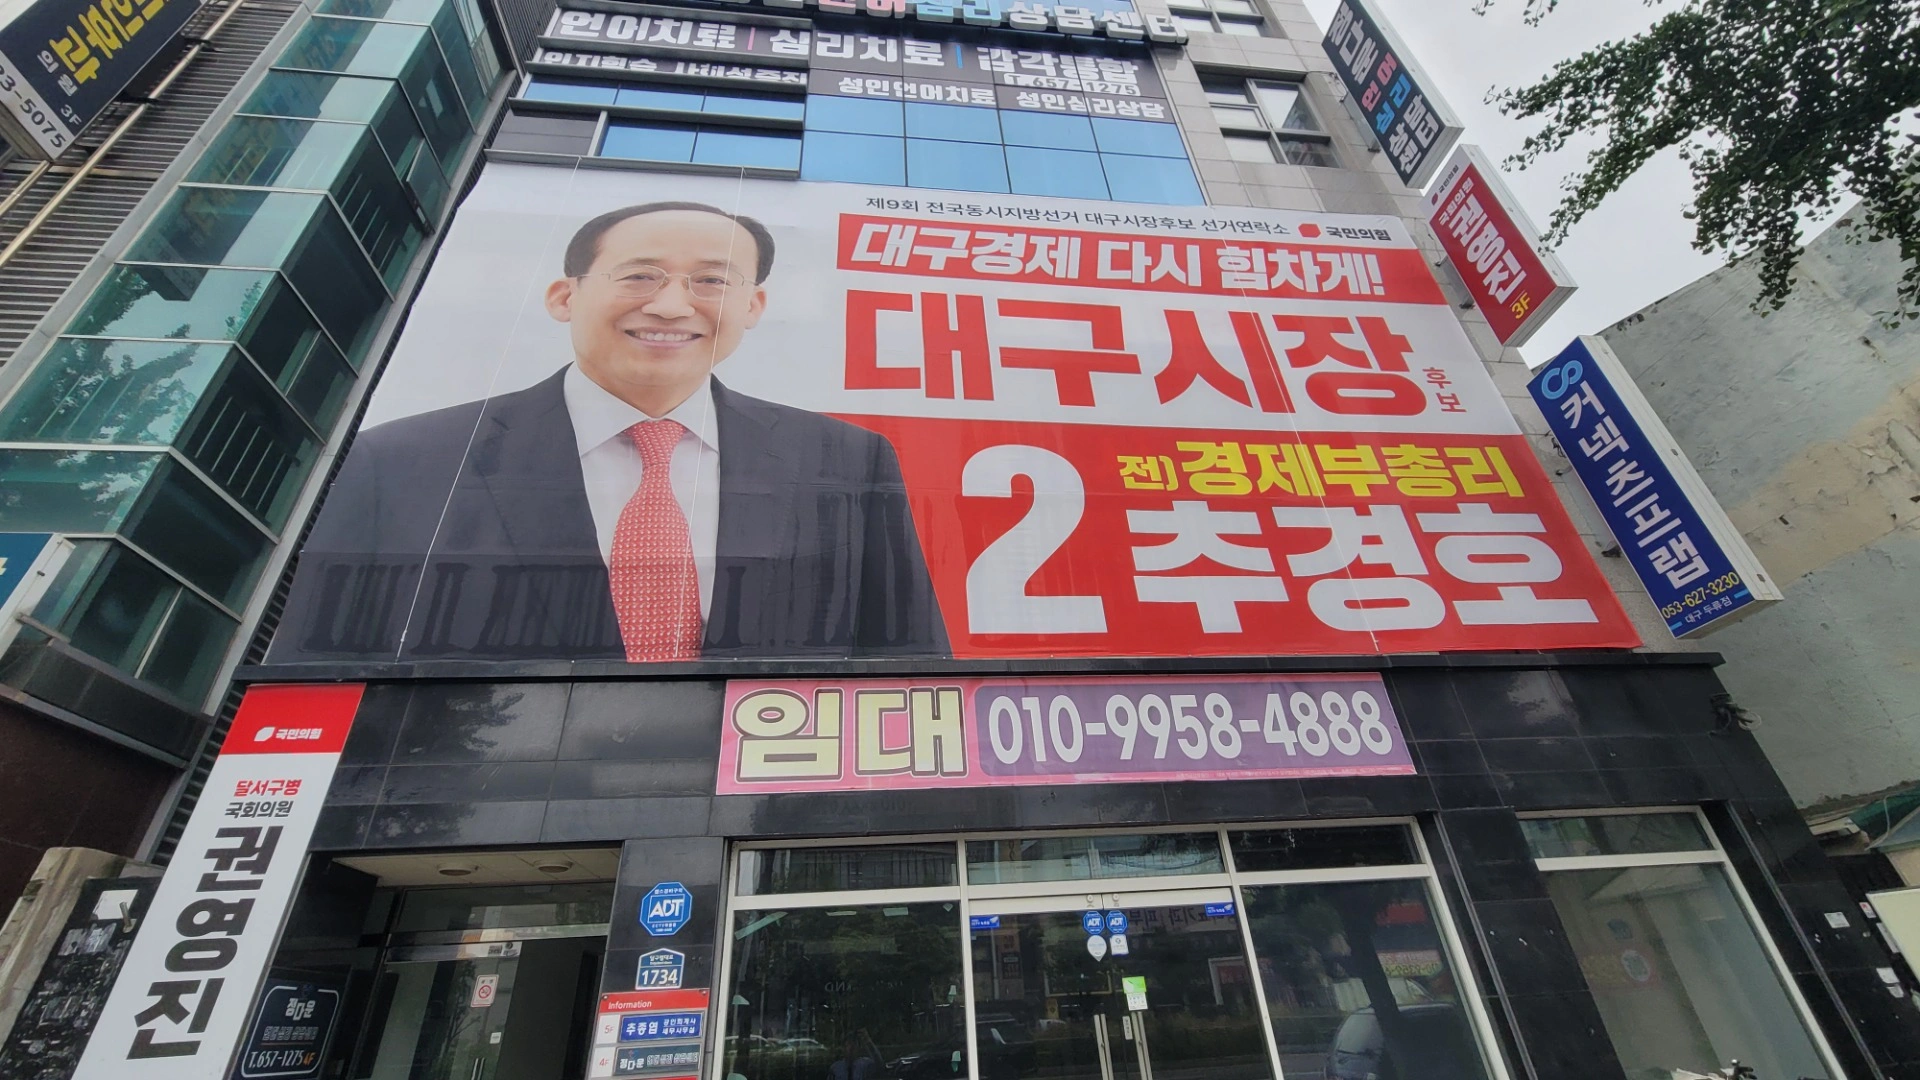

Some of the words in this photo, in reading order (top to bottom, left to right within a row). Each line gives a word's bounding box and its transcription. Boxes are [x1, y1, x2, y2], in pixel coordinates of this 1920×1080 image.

[819, 0, 1190, 44] 심리상담센터
[1328, 1, 1378, 86] 정다운
[560, 11, 736, 49] 언어치료
[769, 29, 945, 66] 심리치료
[976, 46, 1139, 84] 감각통합
[37, 50, 78, 96] 의원
[1362, 52, 1397, 112] 언어
[60, 104, 82, 126] 3F
[839, 77, 996, 105] 성인언어치료
[1016, 91, 1164, 119] 성인심리상담
[1376, 73, 1411, 135] 심리
[1389, 94, 1427, 157] 상담
[1399, 111, 1439, 174] 센터
[866, 197, 919, 212] 제9회
[926, 201, 1079, 224] 전국동시지방선거
[1085, 212, 1197, 231] 대구시장후보
[1201, 218, 1291, 236] 선거연락소
[1439, 177, 1474, 226] 국회의원
[1326, 226, 1393, 242] 국민의힘
[1449, 193, 1527, 304] 권영진
[851, 222, 1082, 280] 대구경제
[1096, 239, 1202, 287] 다시
[1216, 246, 1386, 296] 힘차게!
[1511, 292, 1531, 319] 3F
[843, 289, 1428, 417] 대구시장
[1422, 366, 1467, 413] 후보
[1560, 380, 1710, 589] 커넥츠프랩
[961, 443, 1109, 635] 2
[1125, 500, 1599, 634] 추경호
[1661, 571, 1740, 619] 053-627-3230
[1685, 609, 1702, 623] 대구
[1703, 595, 1733, 615] 두류점
[276, 728, 322, 740] 국민의힘
[732, 687, 969, 781] 임대
[988, 690, 1393, 766] 010-9958-4888
[224, 800, 294, 819] 국회의원
[233, 779, 302, 797] 달서구병
[649, 898, 684, 918] ADT
[1087, 917, 1101, 927] ADT
[1110, 917, 1123, 927] ADT
[126, 825, 284, 1060] 권영진
[642, 968, 678, 985] 1734
[285, 998, 316, 1021] 정다운
[608, 1000, 652, 1010] Information
[604, 1026, 614, 1034] 5F
[248, 1049, 305, 1069] T.657-1275
[303, 1052, 316, 1067] 4F
[600, 1058, 608, 1066] 4F
[619, 1058, 645, 1070] 정다운
